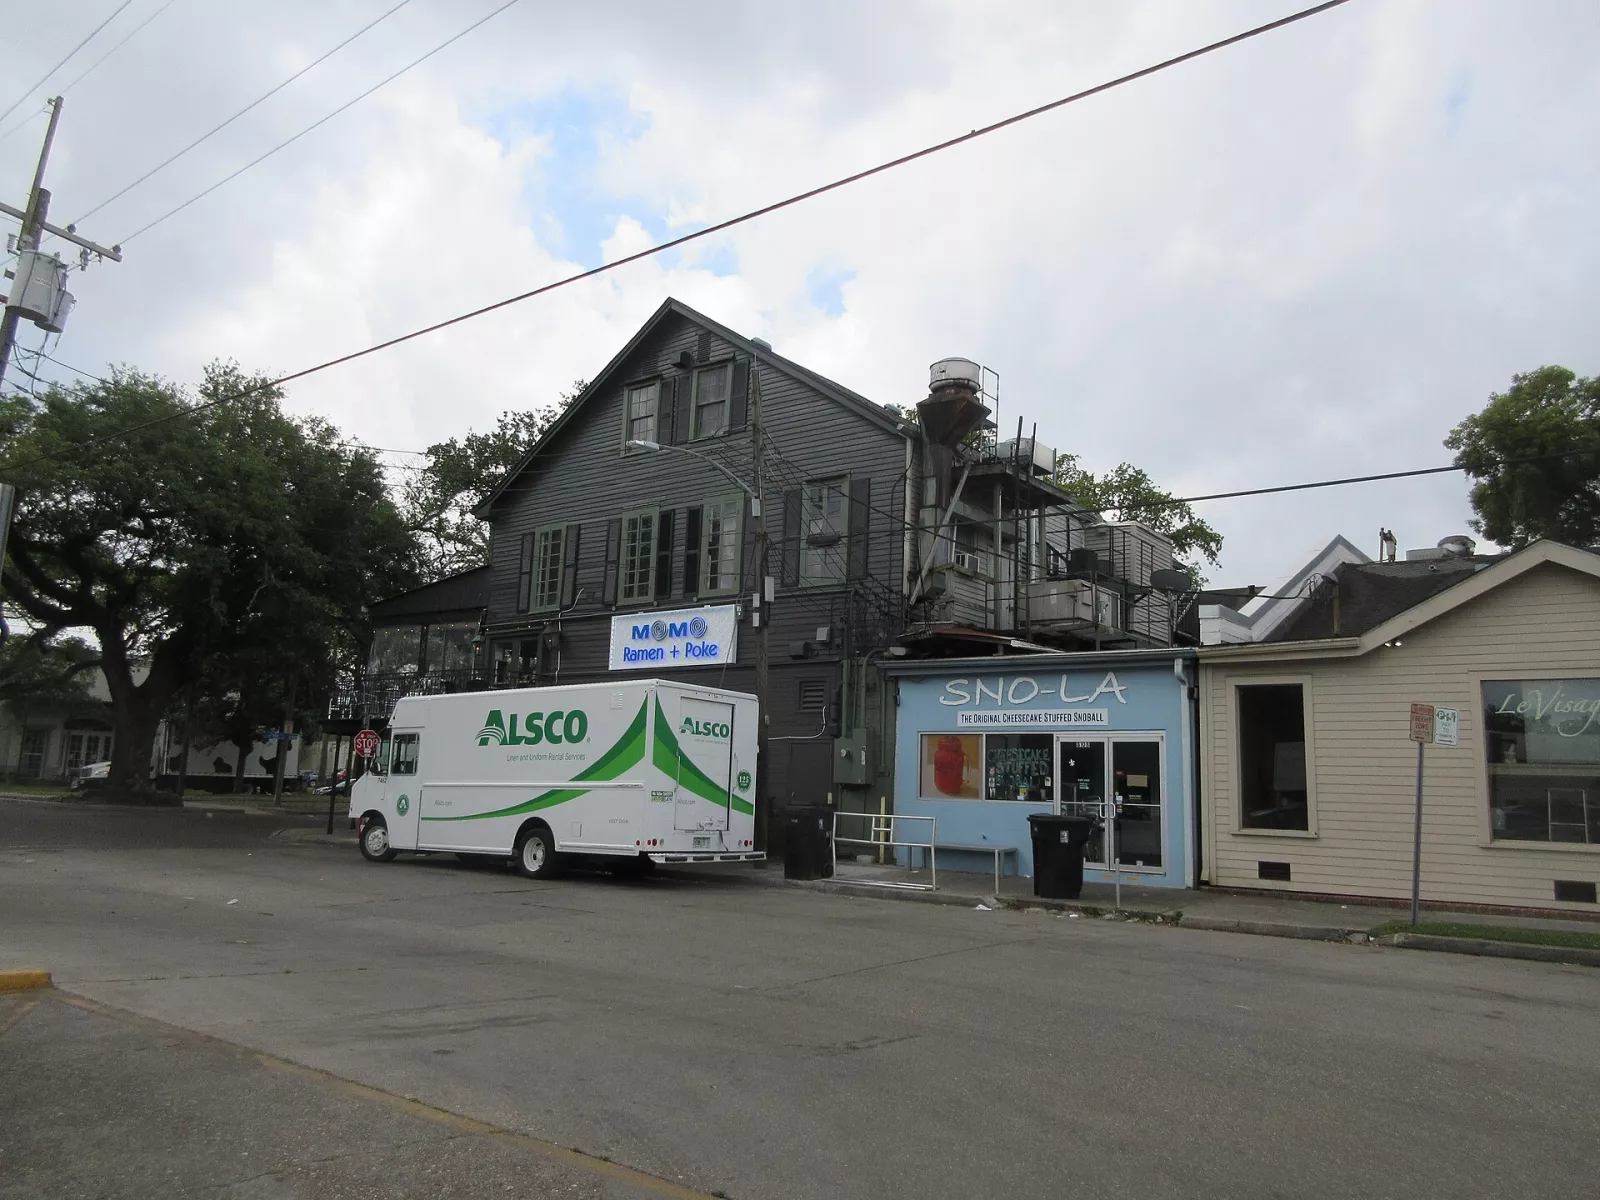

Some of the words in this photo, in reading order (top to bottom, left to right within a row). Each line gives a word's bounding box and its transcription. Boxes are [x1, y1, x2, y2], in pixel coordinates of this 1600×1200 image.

[632, 616, 708, 641] MOMO
[623, 647, 664, 662] Ramen
[670, 645, 679, 658] +
[685, 641, 718, 658] Poke
[939, 671, 1127, 706] SNO-LA
[476, 709, 588, 746] ALSCO
[680, 717, 730, 738] ALSCO
[961, 714, 972, 723] THE
[973, 713, 1000, 723] ORIGINAL
[1002, 713, 1042, 723] CHEESECAKE
[1044, 712, 1072, 722] STUFFED
[1073, 712, 1104, 722] SNOBALL
[356, 738, 379, 748] STOP
[507, 753, 519, 761] Linen
[529, 753, 547, 761] Uniform
